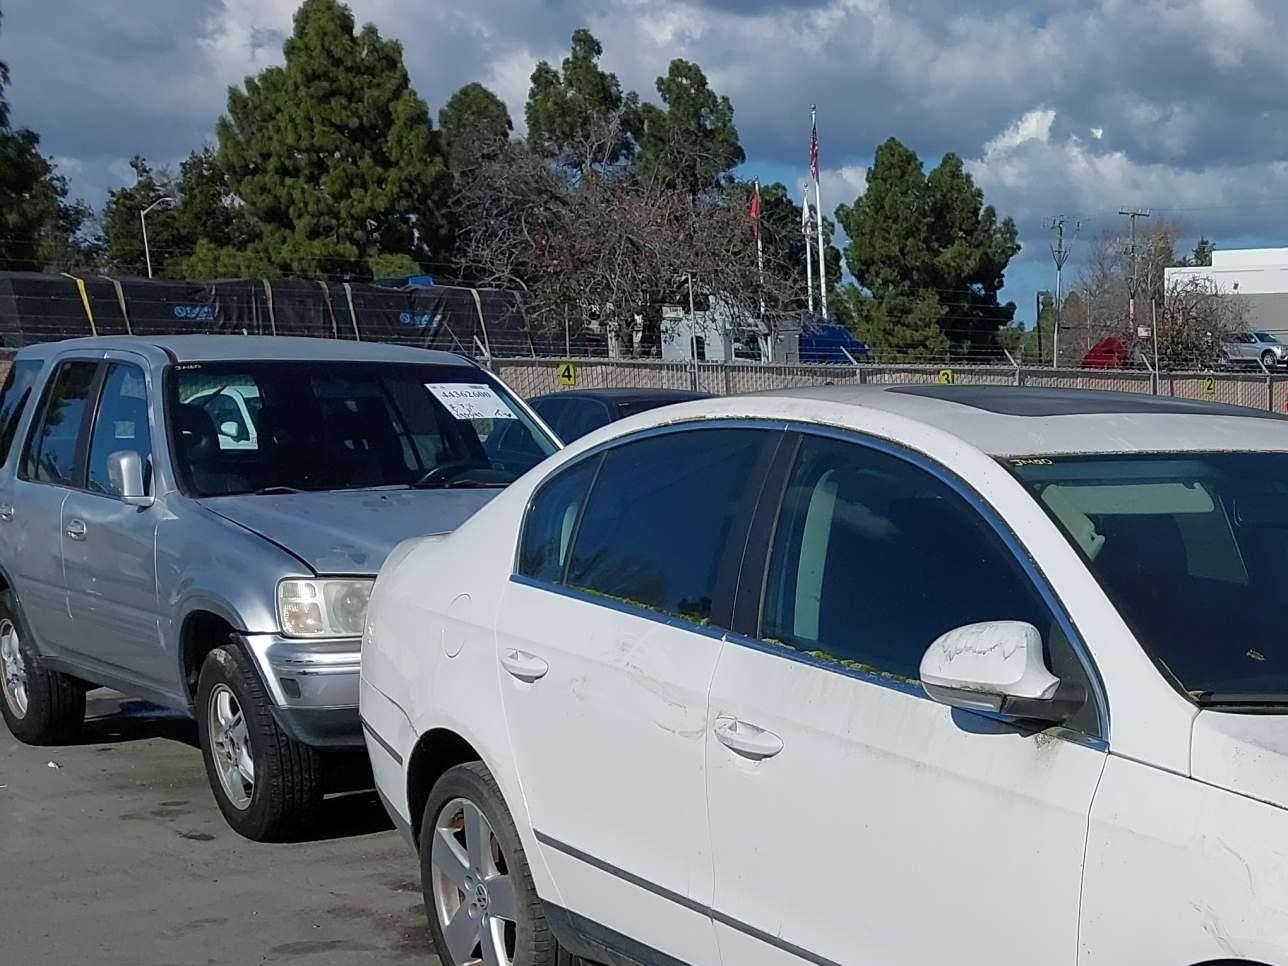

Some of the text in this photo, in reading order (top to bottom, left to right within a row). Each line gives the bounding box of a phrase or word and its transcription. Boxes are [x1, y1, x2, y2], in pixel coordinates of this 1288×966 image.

[561, 364, 573, 382] 4
[941, 371, 951, 385] 3
[1206, 377, 1213, 391] 2
